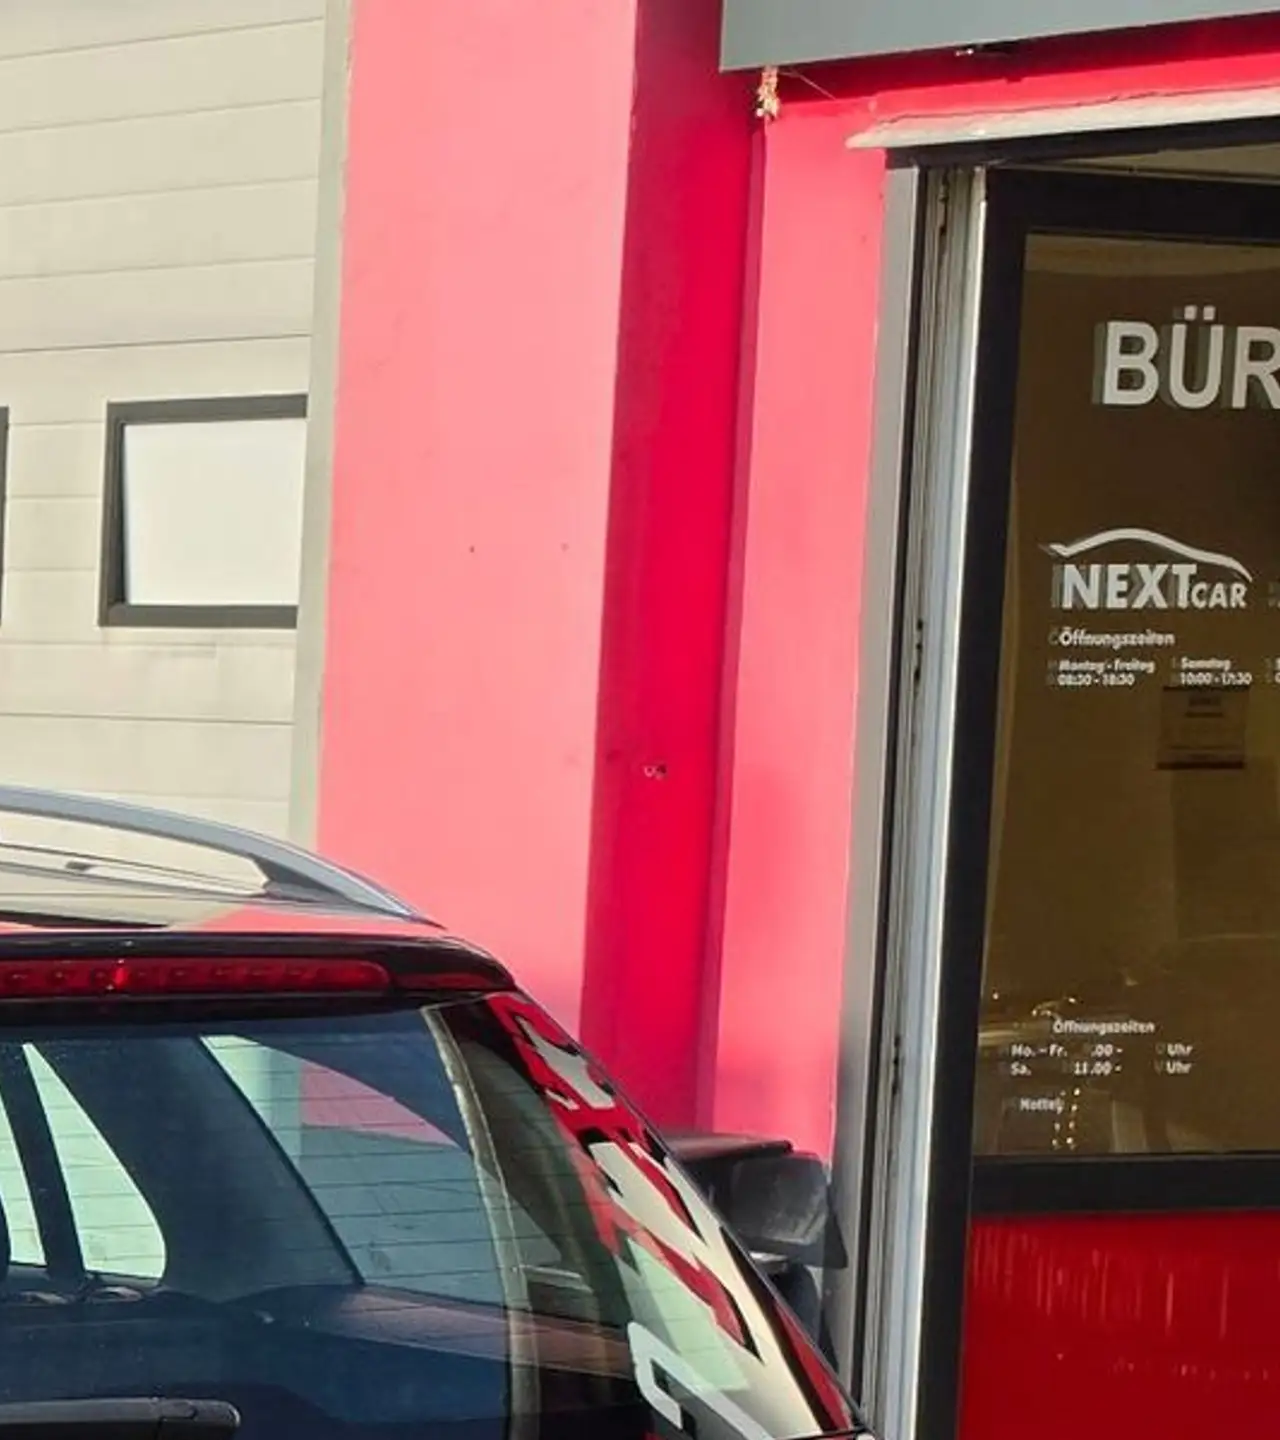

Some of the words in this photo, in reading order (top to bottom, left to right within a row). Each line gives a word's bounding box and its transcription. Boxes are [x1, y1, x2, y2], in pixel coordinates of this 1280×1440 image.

[1059, 626, 1176, 649] Öffnungszeiten
[1053, 1019, 1156, 1036] Öffnungszeiten
[1167, 1044, 1194, 1056] Uhr
[1166, 1062, 1193, 1074] Uhr
